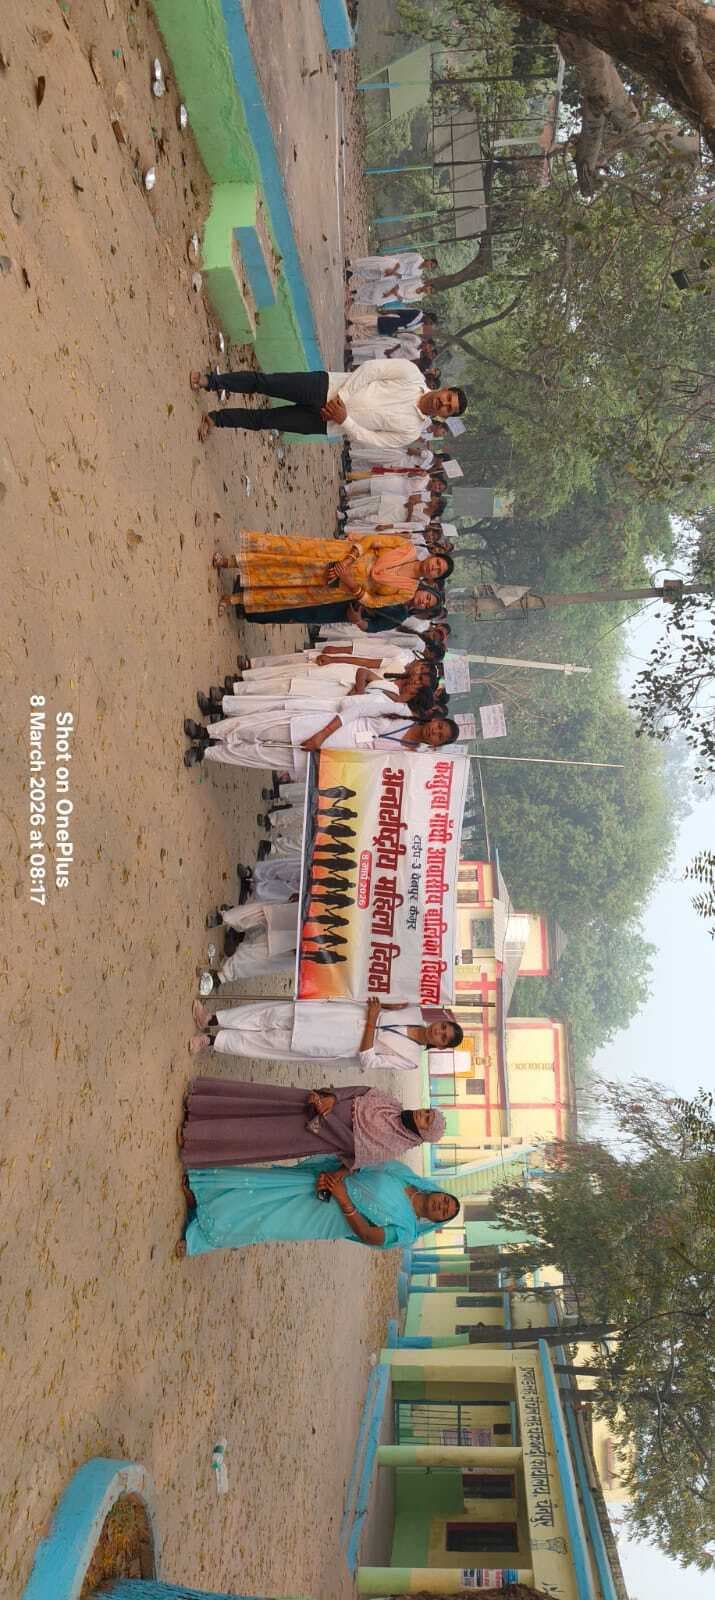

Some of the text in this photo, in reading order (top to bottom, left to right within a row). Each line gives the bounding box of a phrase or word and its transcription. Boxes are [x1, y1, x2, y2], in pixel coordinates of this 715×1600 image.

[358, 882, 367, 906] 2026
[425, 848, 449, 905] आवासीय
[372, 876, 404, 937] महिला
[423, 907, 448, 958] बालिका
[368, 941, 401, 994] दिवस
